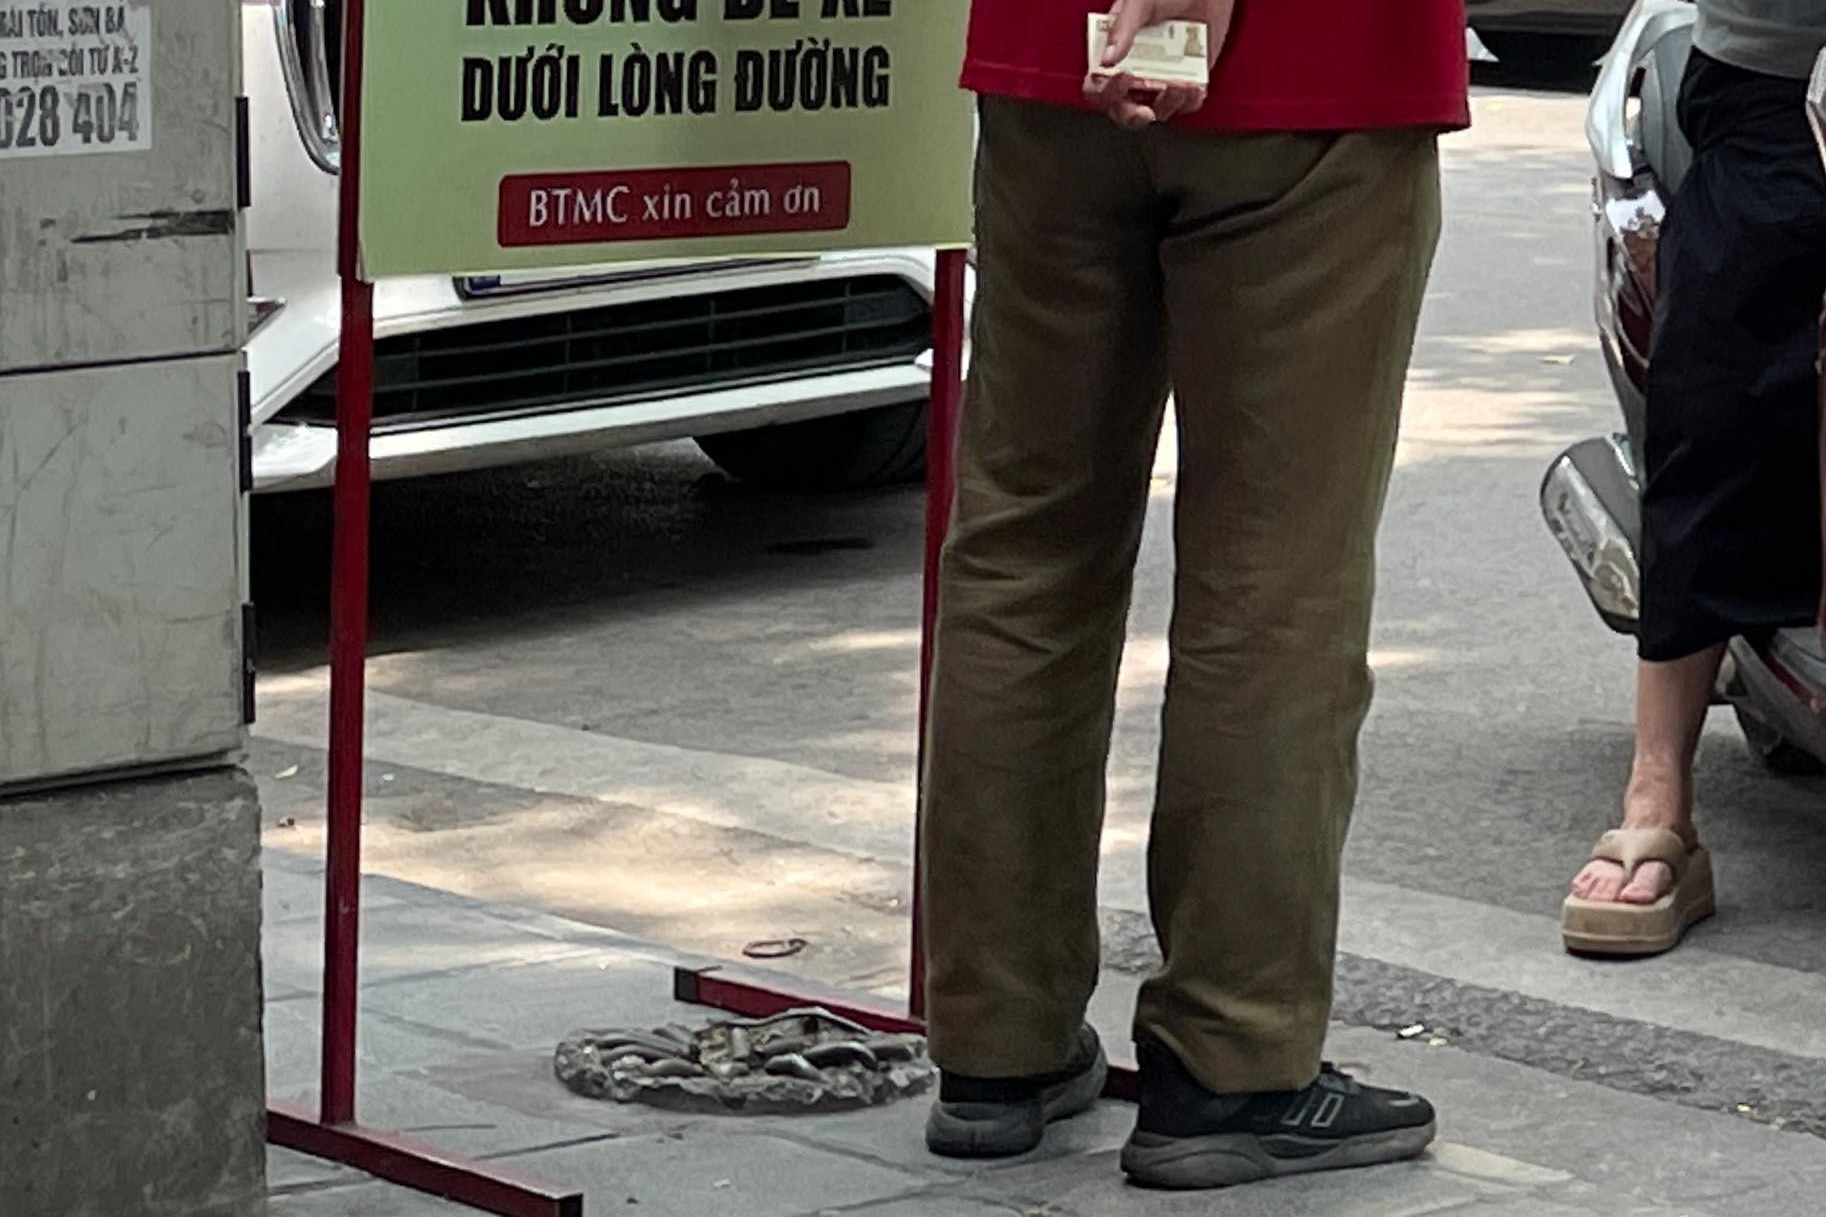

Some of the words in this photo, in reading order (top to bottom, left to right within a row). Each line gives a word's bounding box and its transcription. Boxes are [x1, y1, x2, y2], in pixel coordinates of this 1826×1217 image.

[461, 42, 581, 122] DƯỚI
[598, 42, 717, 117] LÒNG
[734, 37, 890, 113] ĐƯỜNG
[72, 81, 140, 145] 404
[529, 185, 629, 229] BTMC
[642, 182, 692, 220] xin
[706, 177, 771, 219] cảm
[783, 183, 821, 215] ơn
